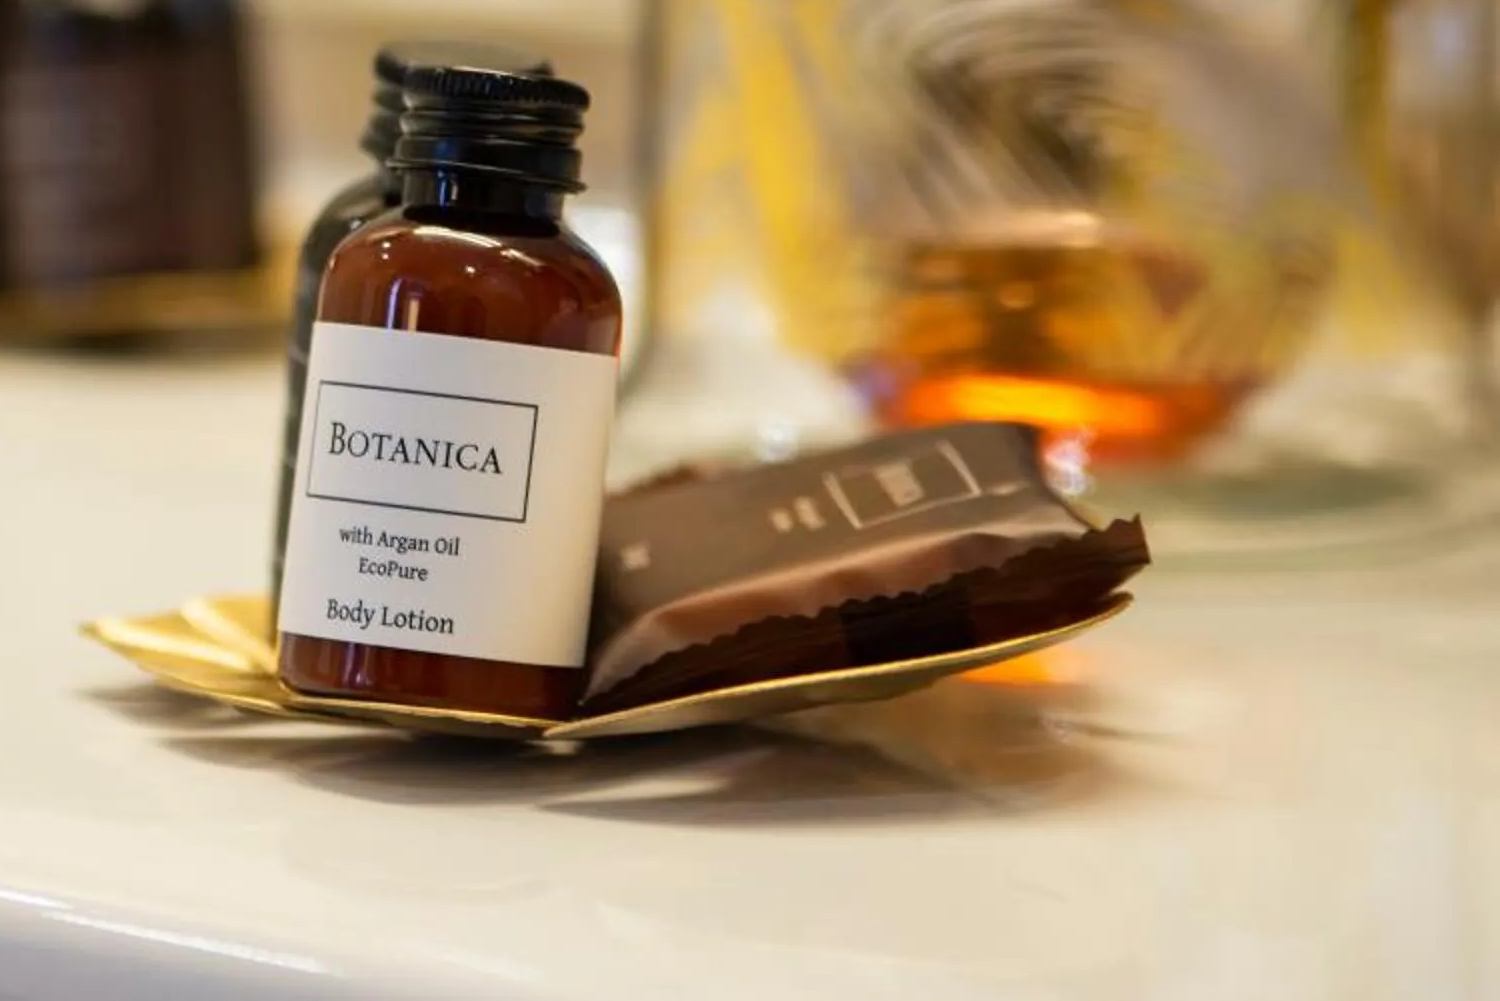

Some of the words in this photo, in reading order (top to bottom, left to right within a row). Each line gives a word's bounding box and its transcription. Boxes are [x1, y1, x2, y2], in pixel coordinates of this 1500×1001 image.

[328, 421, 503, 475] BOTANICA
[338, 526, 373, 547] with
[377, 530, 430, 554] Argan
[434, 536, 460, 556] Oil
[358, 556, 429, 582] EcoPure
[326, 598, 375, 630] Body
[381, 605, 455, 635] Lotion
